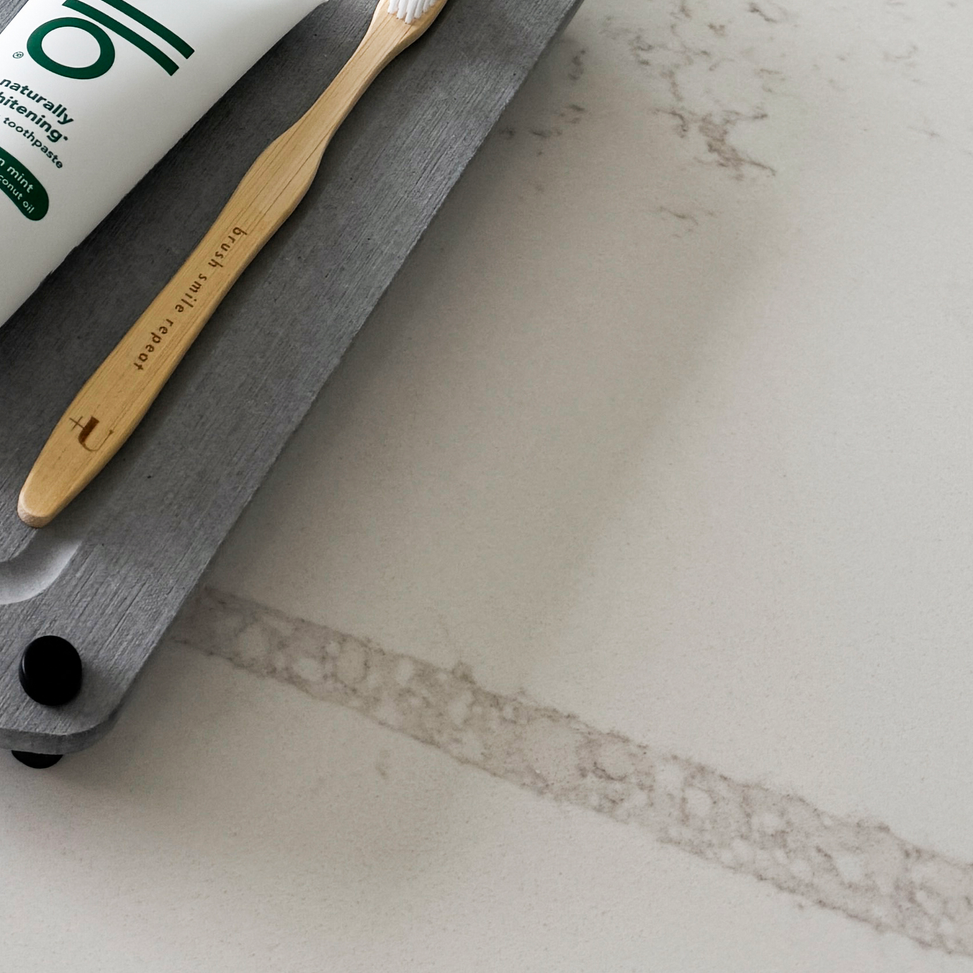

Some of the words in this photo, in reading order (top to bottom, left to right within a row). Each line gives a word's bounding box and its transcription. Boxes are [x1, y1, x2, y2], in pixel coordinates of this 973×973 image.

[0, 79, 74, 125] naturally
[3, 117, 64, 169] toothpaste
[6, 165, 34, 194] mint
[22, 200, 35, 214] oil
[208, 226, 248, 268] brush
[174, 273, 208, 313] smile
[133, 318, 174, 371] repeat
